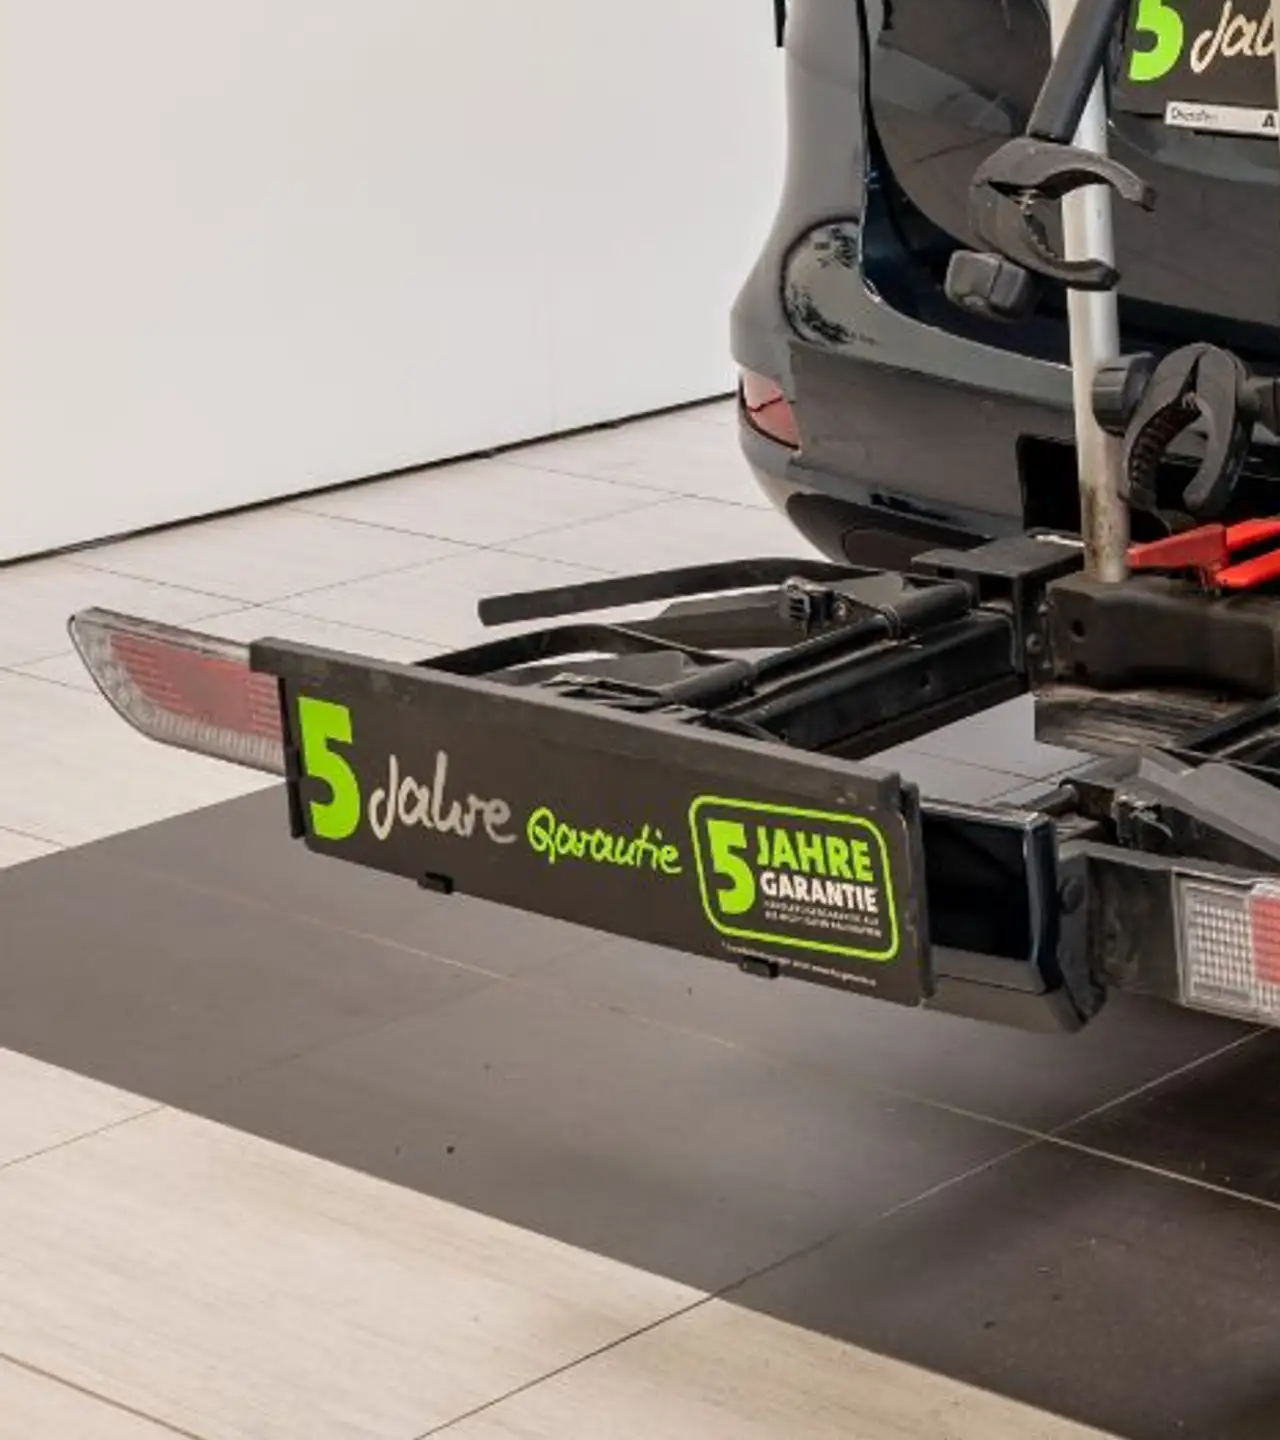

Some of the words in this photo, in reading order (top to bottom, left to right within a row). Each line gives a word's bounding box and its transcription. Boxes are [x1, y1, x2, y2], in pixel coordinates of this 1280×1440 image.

[298, 697, 360, 841] 5
[369, 751, 517, 842] Jahre
[708, 819, 756, 914] 5
[757, 825, 874, 882] JAHRE
[760, 871, 878, 914] GARANTIE
